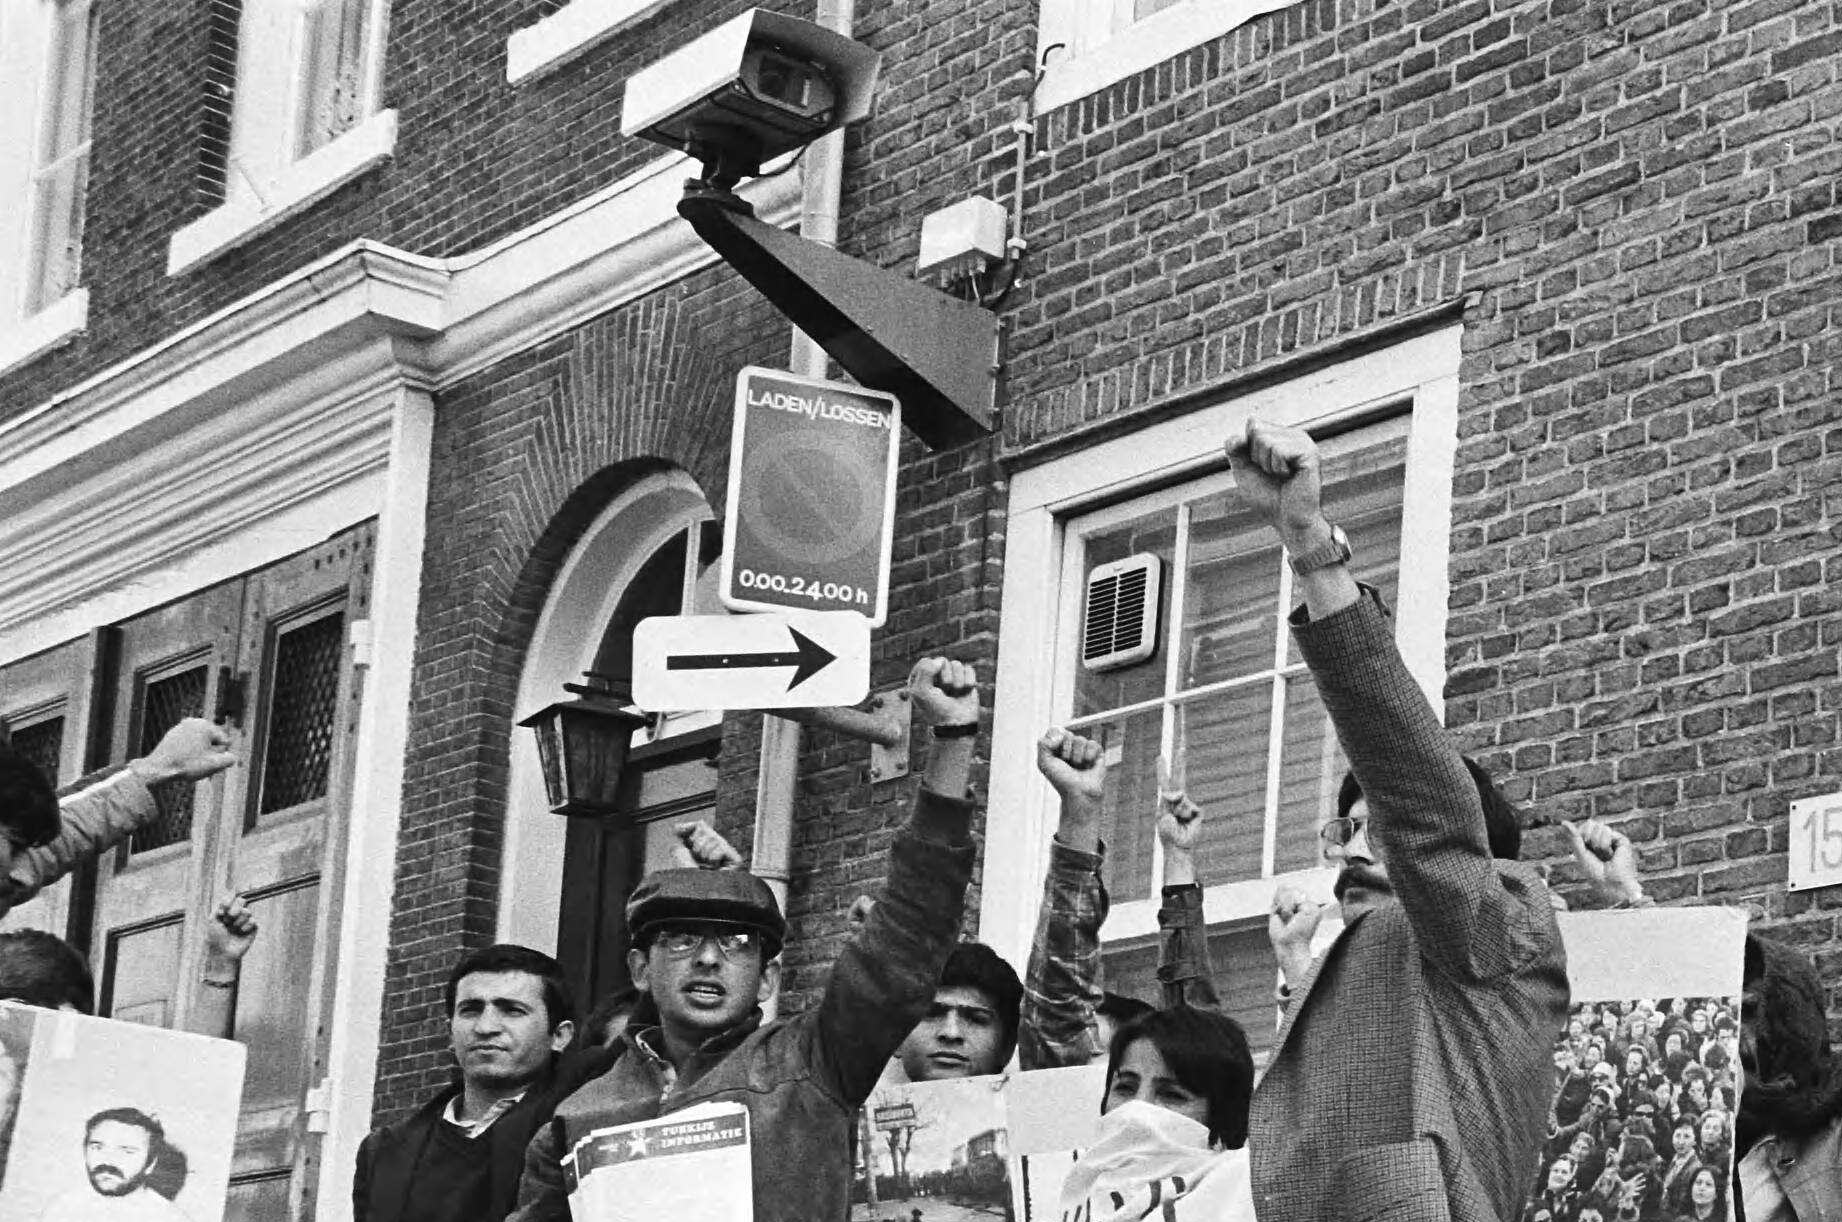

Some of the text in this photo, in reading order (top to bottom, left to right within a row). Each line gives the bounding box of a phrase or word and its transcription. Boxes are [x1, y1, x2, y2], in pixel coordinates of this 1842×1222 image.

[748, 389, 891, 429] LADEN/LOSSEN
[856, 588, 868, 604] h
[661, 1121, 715, 1136] TURKIJE
[661, 1128, 743, 1148] INFORMATIE
